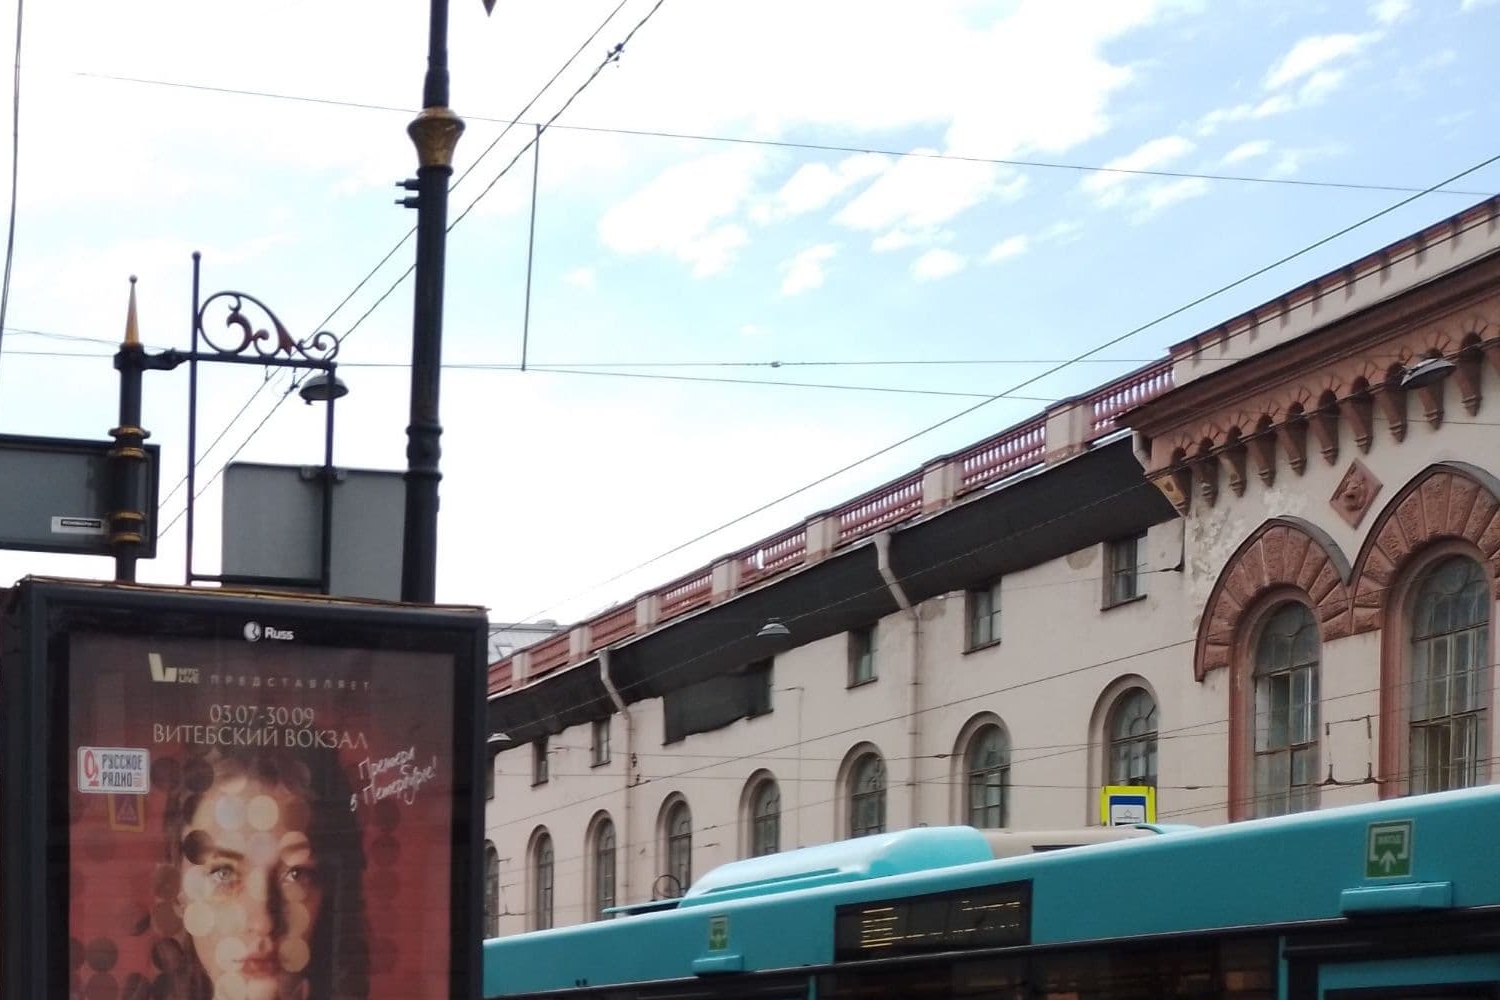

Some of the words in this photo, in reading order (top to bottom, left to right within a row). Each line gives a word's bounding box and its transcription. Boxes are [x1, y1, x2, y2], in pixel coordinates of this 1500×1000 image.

[264, 626, 294, 641] Russ
[210, 674, 372, 691] ПРЕДСТАВЛЯЕТ
[209, 704, 315, 727] 03.07-30.09
[153, 723, 278, 747] ВИТЕБСКИЙ
[284, 728, 369, 750] ВОКЗАЛ
[101, 753, 143, 770] РУССКОЕ
[101, 771, 133, 787] РАДИО
